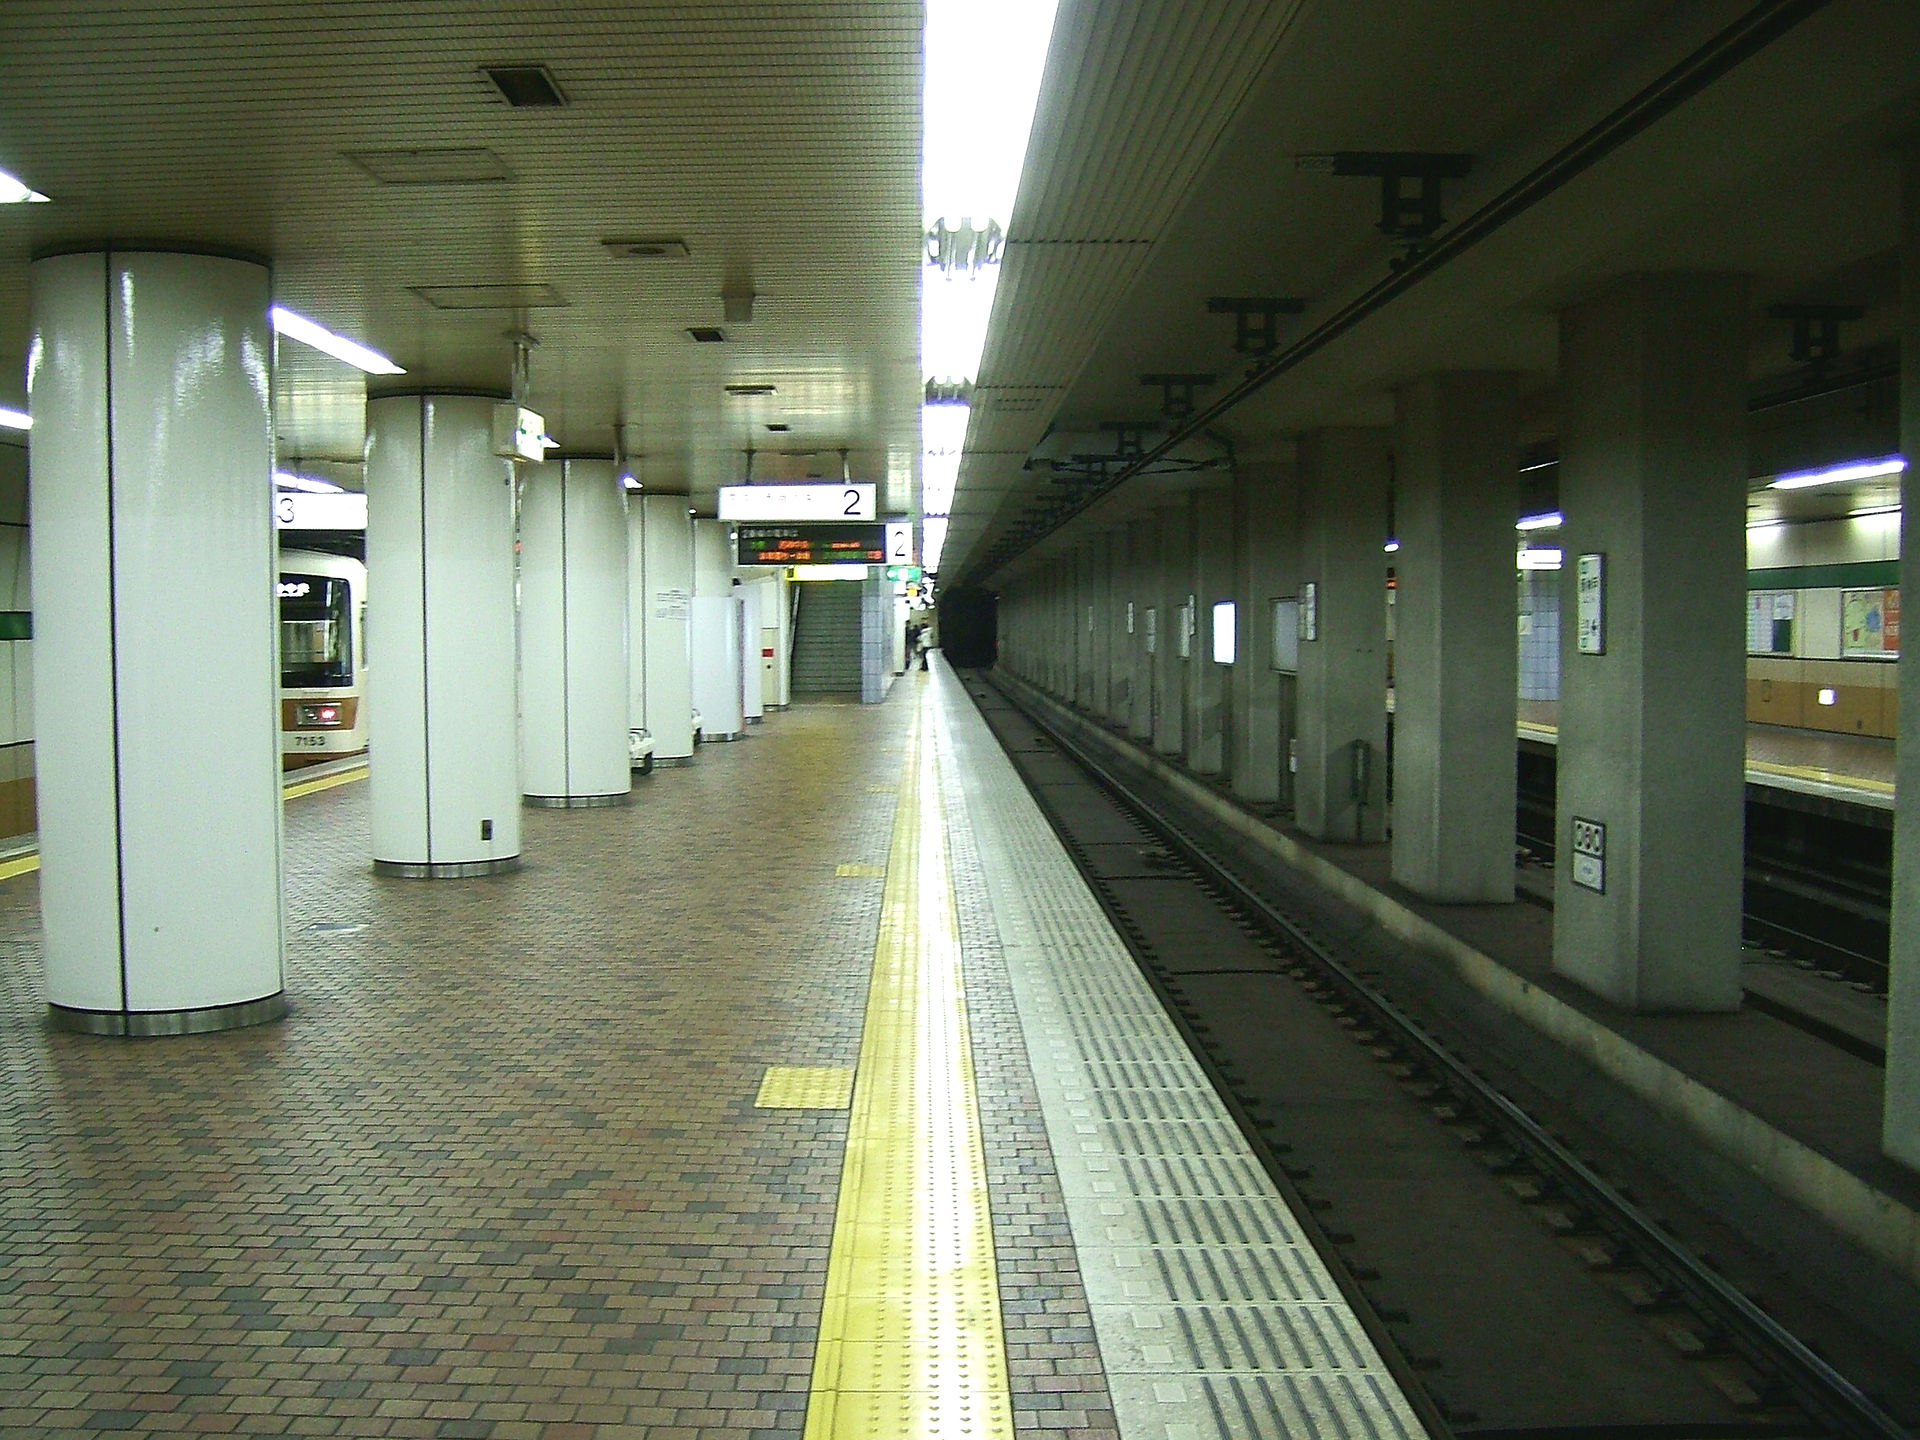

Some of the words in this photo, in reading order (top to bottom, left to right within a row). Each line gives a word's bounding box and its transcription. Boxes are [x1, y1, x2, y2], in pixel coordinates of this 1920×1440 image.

[277, 497, 295, 524] 3
[843, 489, 861, 515] 2
[894, 531, 906, 557] 2
[294, 735, 326, 747] 7153
